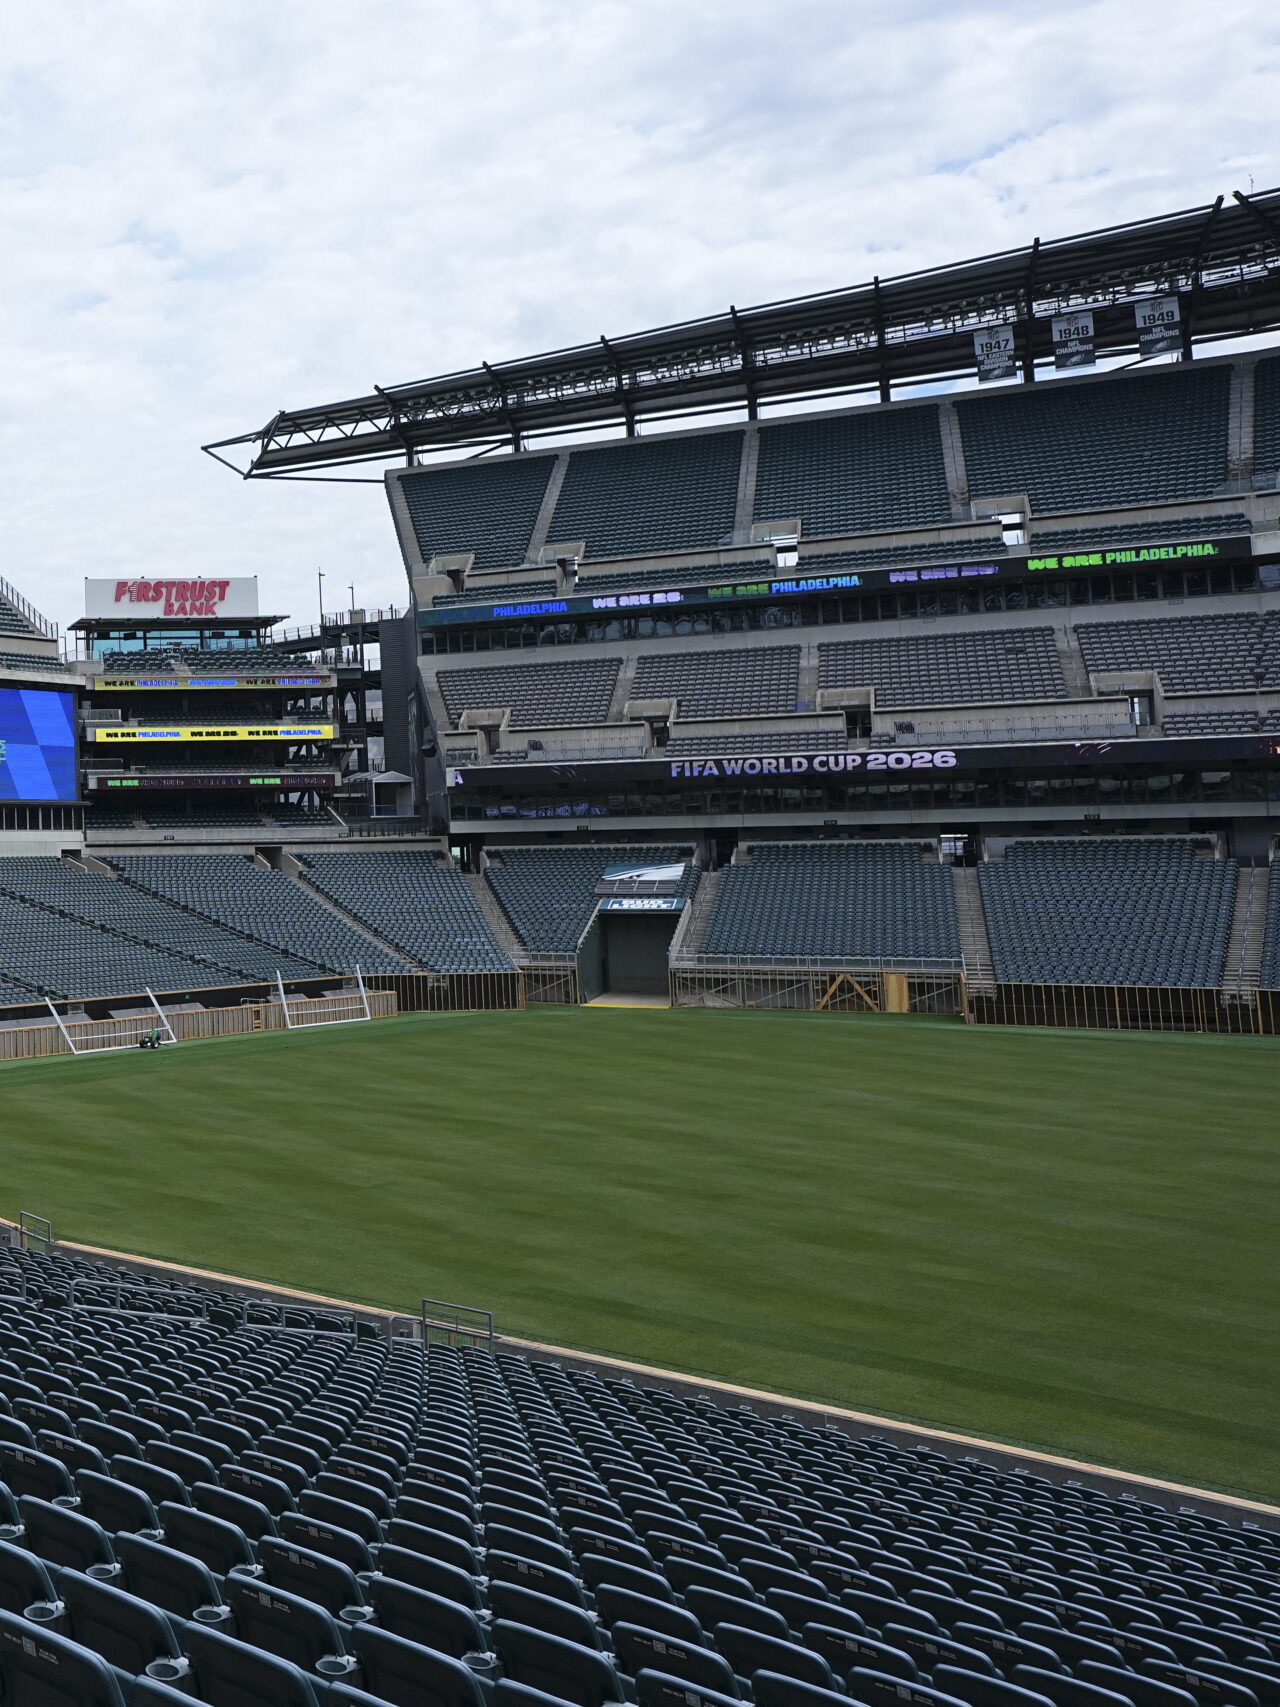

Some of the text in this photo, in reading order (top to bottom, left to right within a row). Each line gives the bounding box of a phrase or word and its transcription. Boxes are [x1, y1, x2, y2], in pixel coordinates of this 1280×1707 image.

[1141, 311, 1174, 325] 1949
[1058, 326, 1089, 339] 1948
[1140, 329, 1179, 341] CHAMPIONS
[979, 339, 1009, 353] 1947
[1056, 344, 1093, 355] CHAMPIONS
[1068, 340, 1080, 348] NFL
[989, 350, 1013, 359] EASTERN
[1027, 557, 1059, 571] WE
[1062, 553, 1103, 568] ARE
[1105, 543, 1214, 564] PHILADELPHIA
[889, 570, 918, 583] WE
[920, 567, 958, 581] ARE
[708, 575, 860, 598] WE ARE PHILADELPHIA
[164, 601, 218, 616] BANK
[593, 597, 617, 609] WE
[619, 594, 651, 607] ARE
[493, 601, 567, 617] PHILADELPHIA
[670, 751, 957, 777] FIFA WORLD CUP 2026
